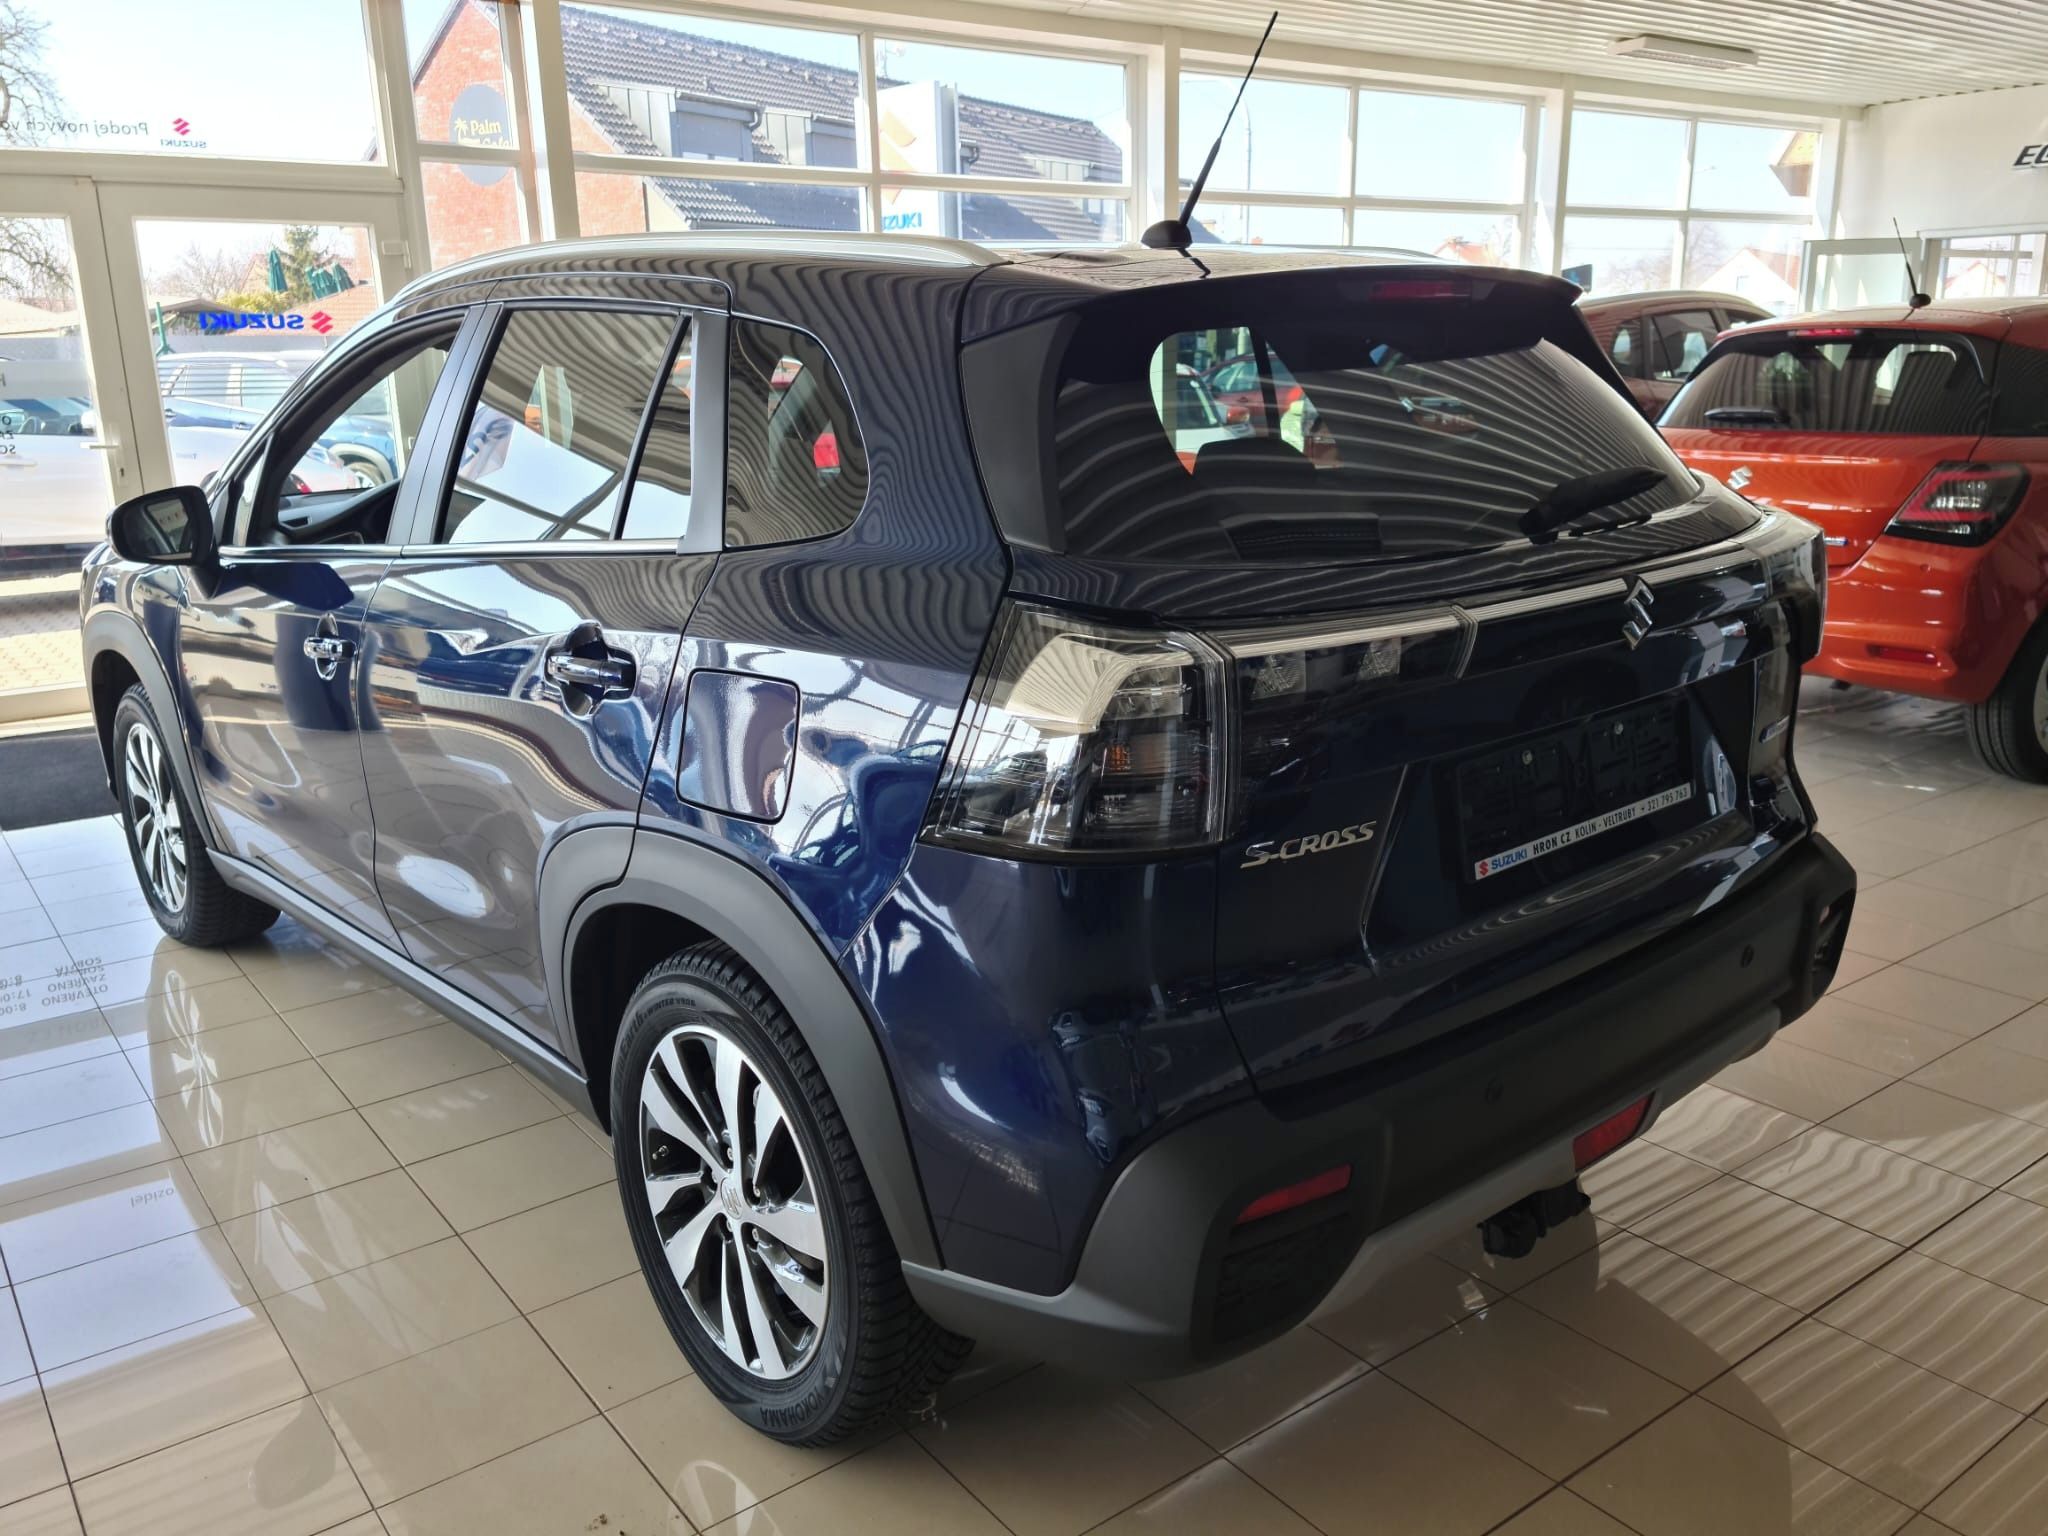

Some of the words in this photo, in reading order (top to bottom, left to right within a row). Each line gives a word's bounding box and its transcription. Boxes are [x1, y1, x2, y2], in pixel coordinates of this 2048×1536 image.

[470, 119, 501, 135] Palm
[881, 211, 922, 230] ZUKI
[1239, 820, 1377, 869] S-CROSS
[1491, 848, 1528, 870] SUZUKI
[1533, 836, 1558, 855] HRON
[1560, 831, 1572, 844] CZ
[1574, 819, 1597, 839] KOLÍN
[1602, 807, 1636, 829] VELTRUBY
[1647, 797, 1659, 811] 321
[1661, 792, 1674, 806] 795
[1675, 786, 1688, 801] 763
[760, 1385, 825, 1428] YOKOHAMA
